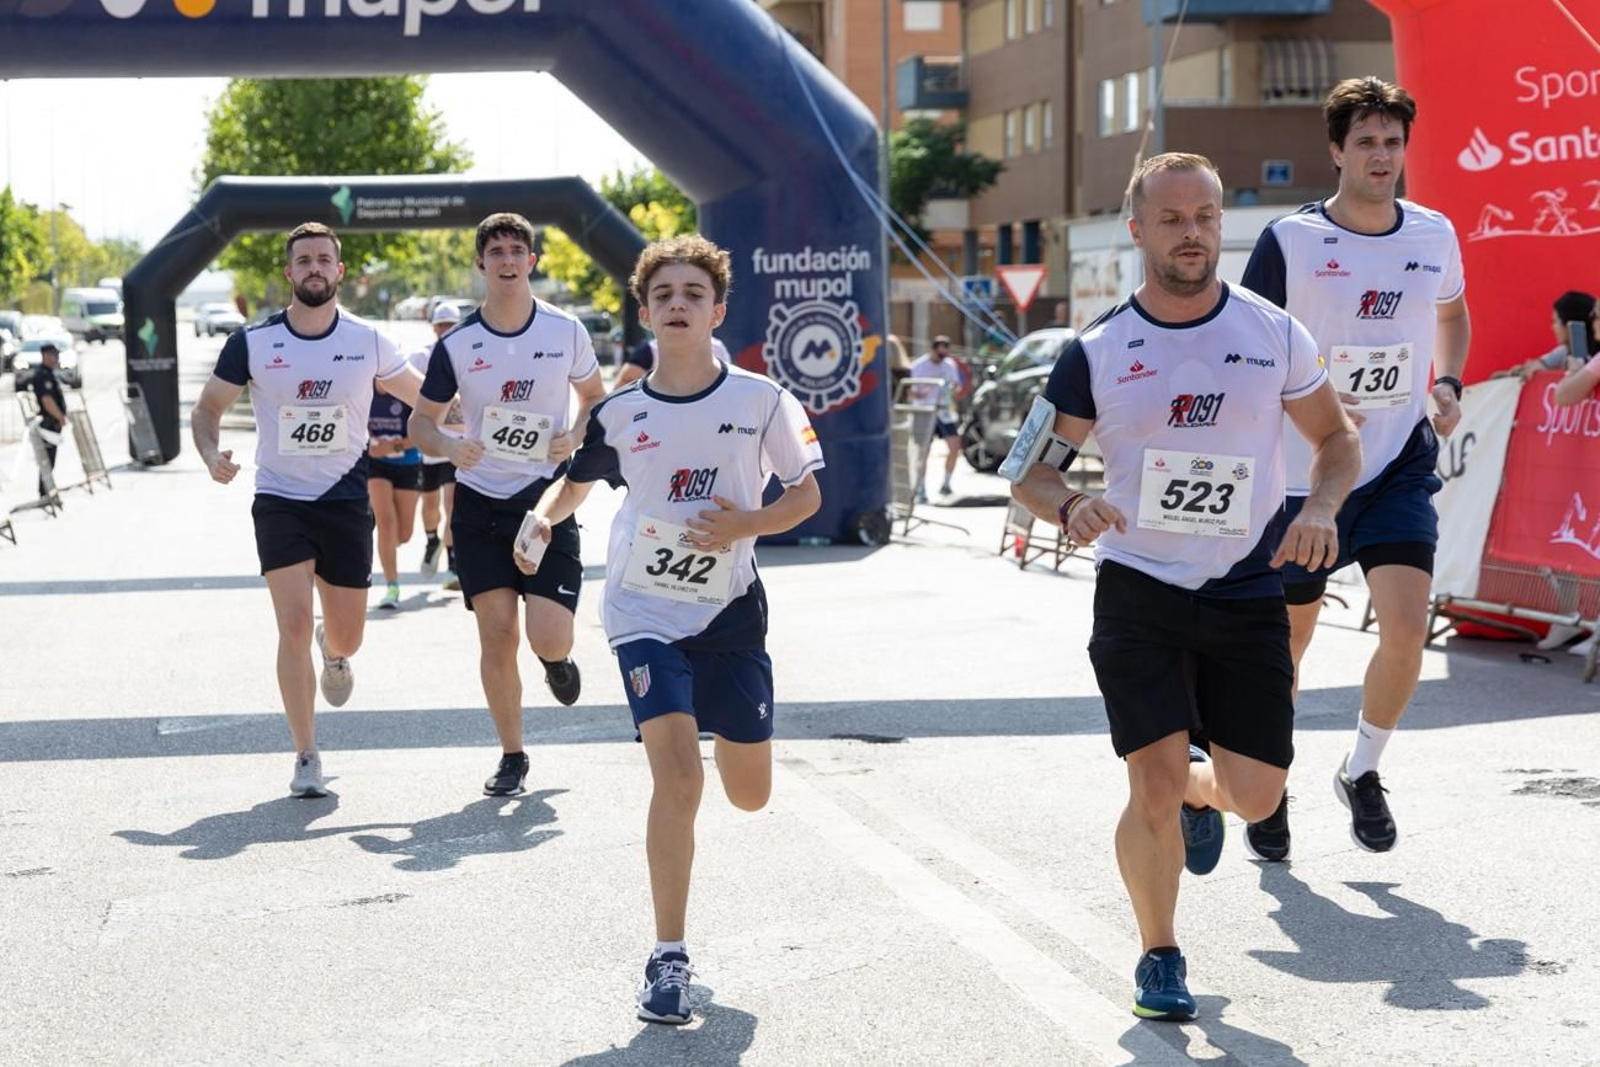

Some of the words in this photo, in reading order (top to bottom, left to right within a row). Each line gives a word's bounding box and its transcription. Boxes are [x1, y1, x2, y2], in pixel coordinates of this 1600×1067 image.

[1515, 66, 1600, 109] Spor
[1508, 125, 1600, 165] Sant
[752, 245, 871, 274] fundación
[774, 272, 853, 302] mupol
[1117, 369, 1158, 384] Santander
[1246, 357, 1276, 368] mupol
[1349, 365, 1399, 392] 130
[291, 423, 336, 443] 468
[492, 426, 539, 450] 469
[630, 440, 661, 453] Santander
[1160, 479, 1235, 515] 523
[646, 547, 717, 585] 342
